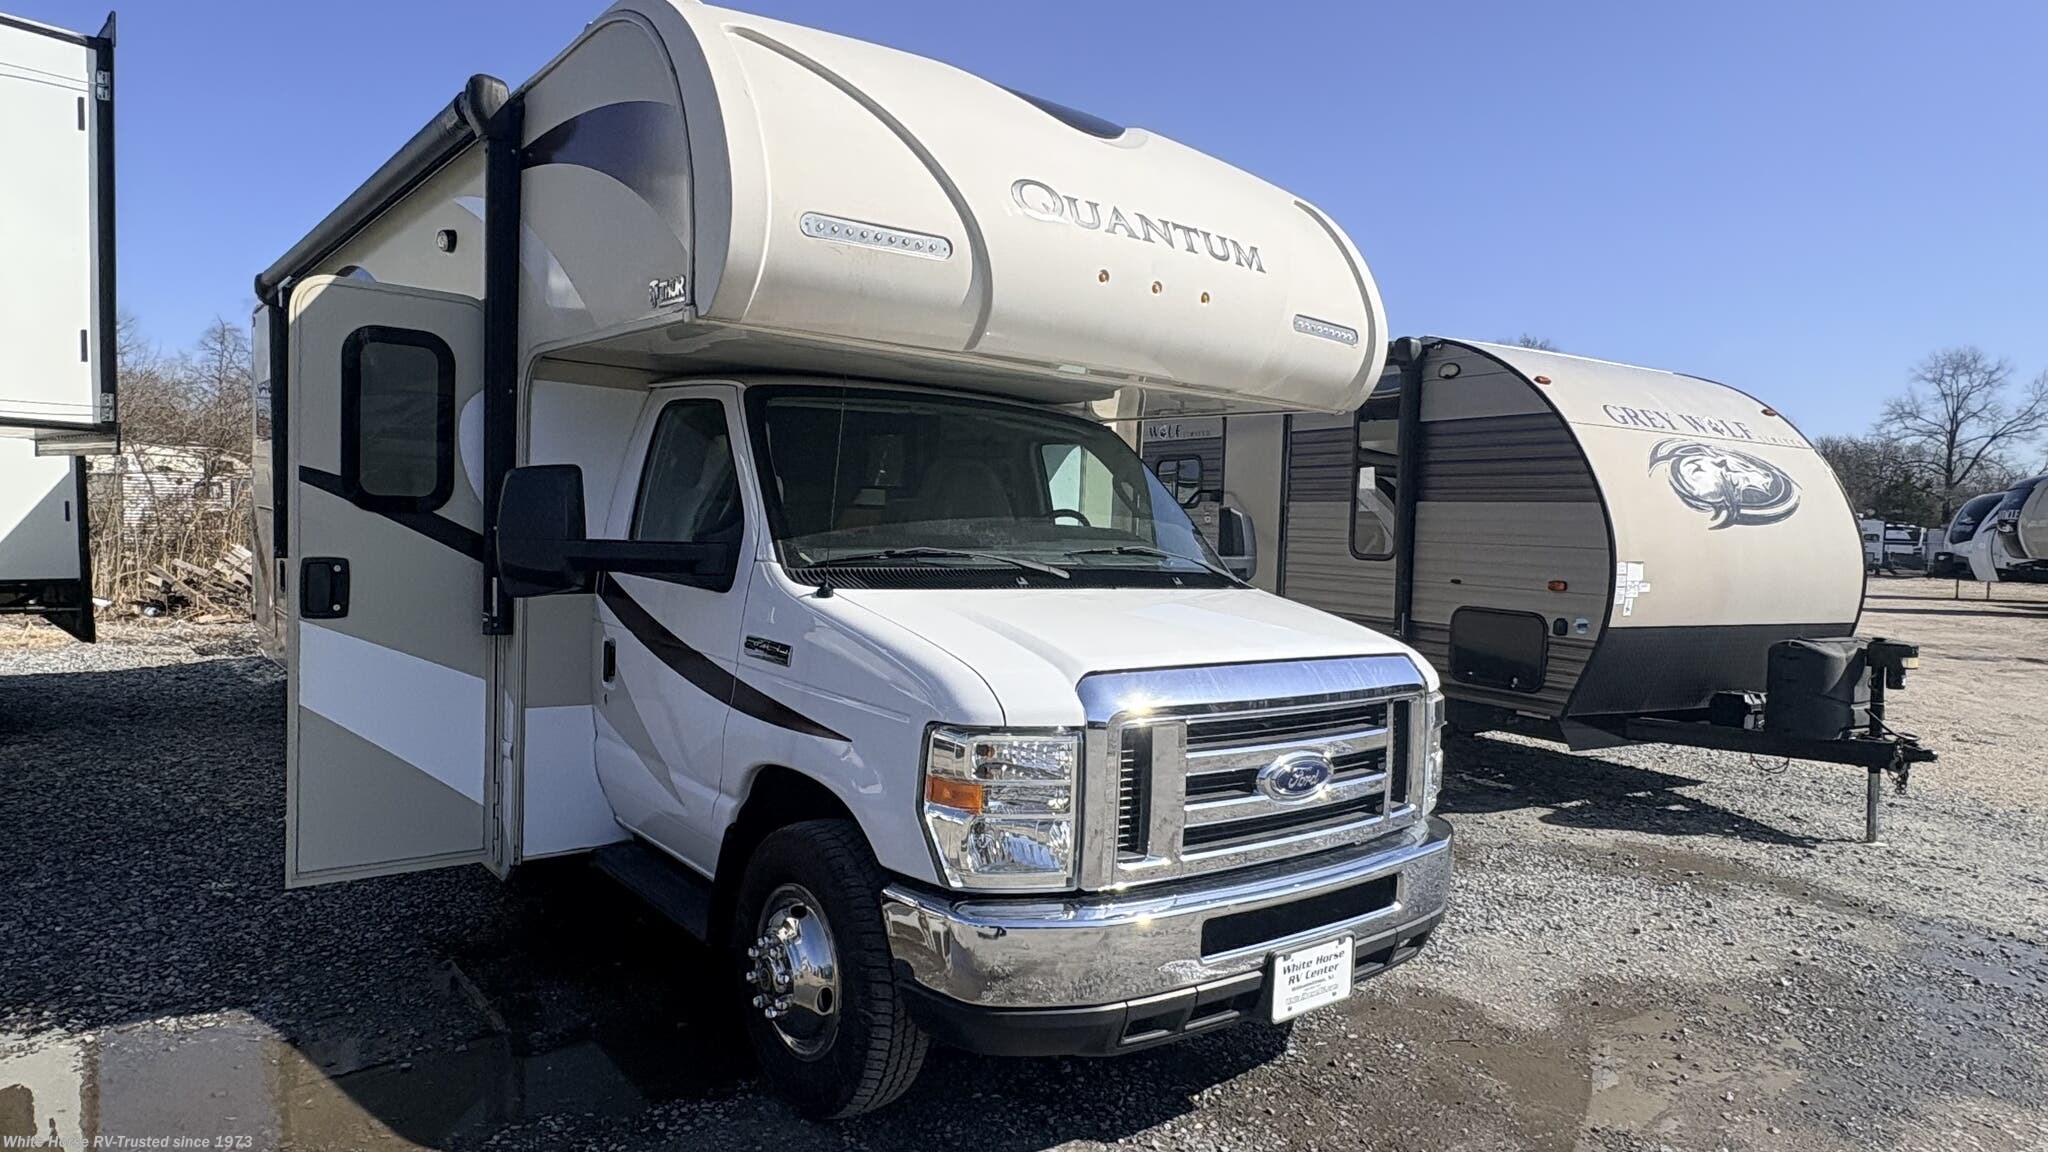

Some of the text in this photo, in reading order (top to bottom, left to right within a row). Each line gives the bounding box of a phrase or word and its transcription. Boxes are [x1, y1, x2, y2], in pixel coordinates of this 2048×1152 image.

[1010, 178, 1267, 274] QUANTUM
[1148, 423, 1184, 439] WOLF
[1602, 404, 1679, 431] GREY
[1678, 413, 1753, 440] WOLF
[1288, 767, 1320, 789] Ford
[1283, 950, 1345, 975] White Horse
[1288, 972, 1303, 985] RV
[1305, 963, 1339, 980] Center
